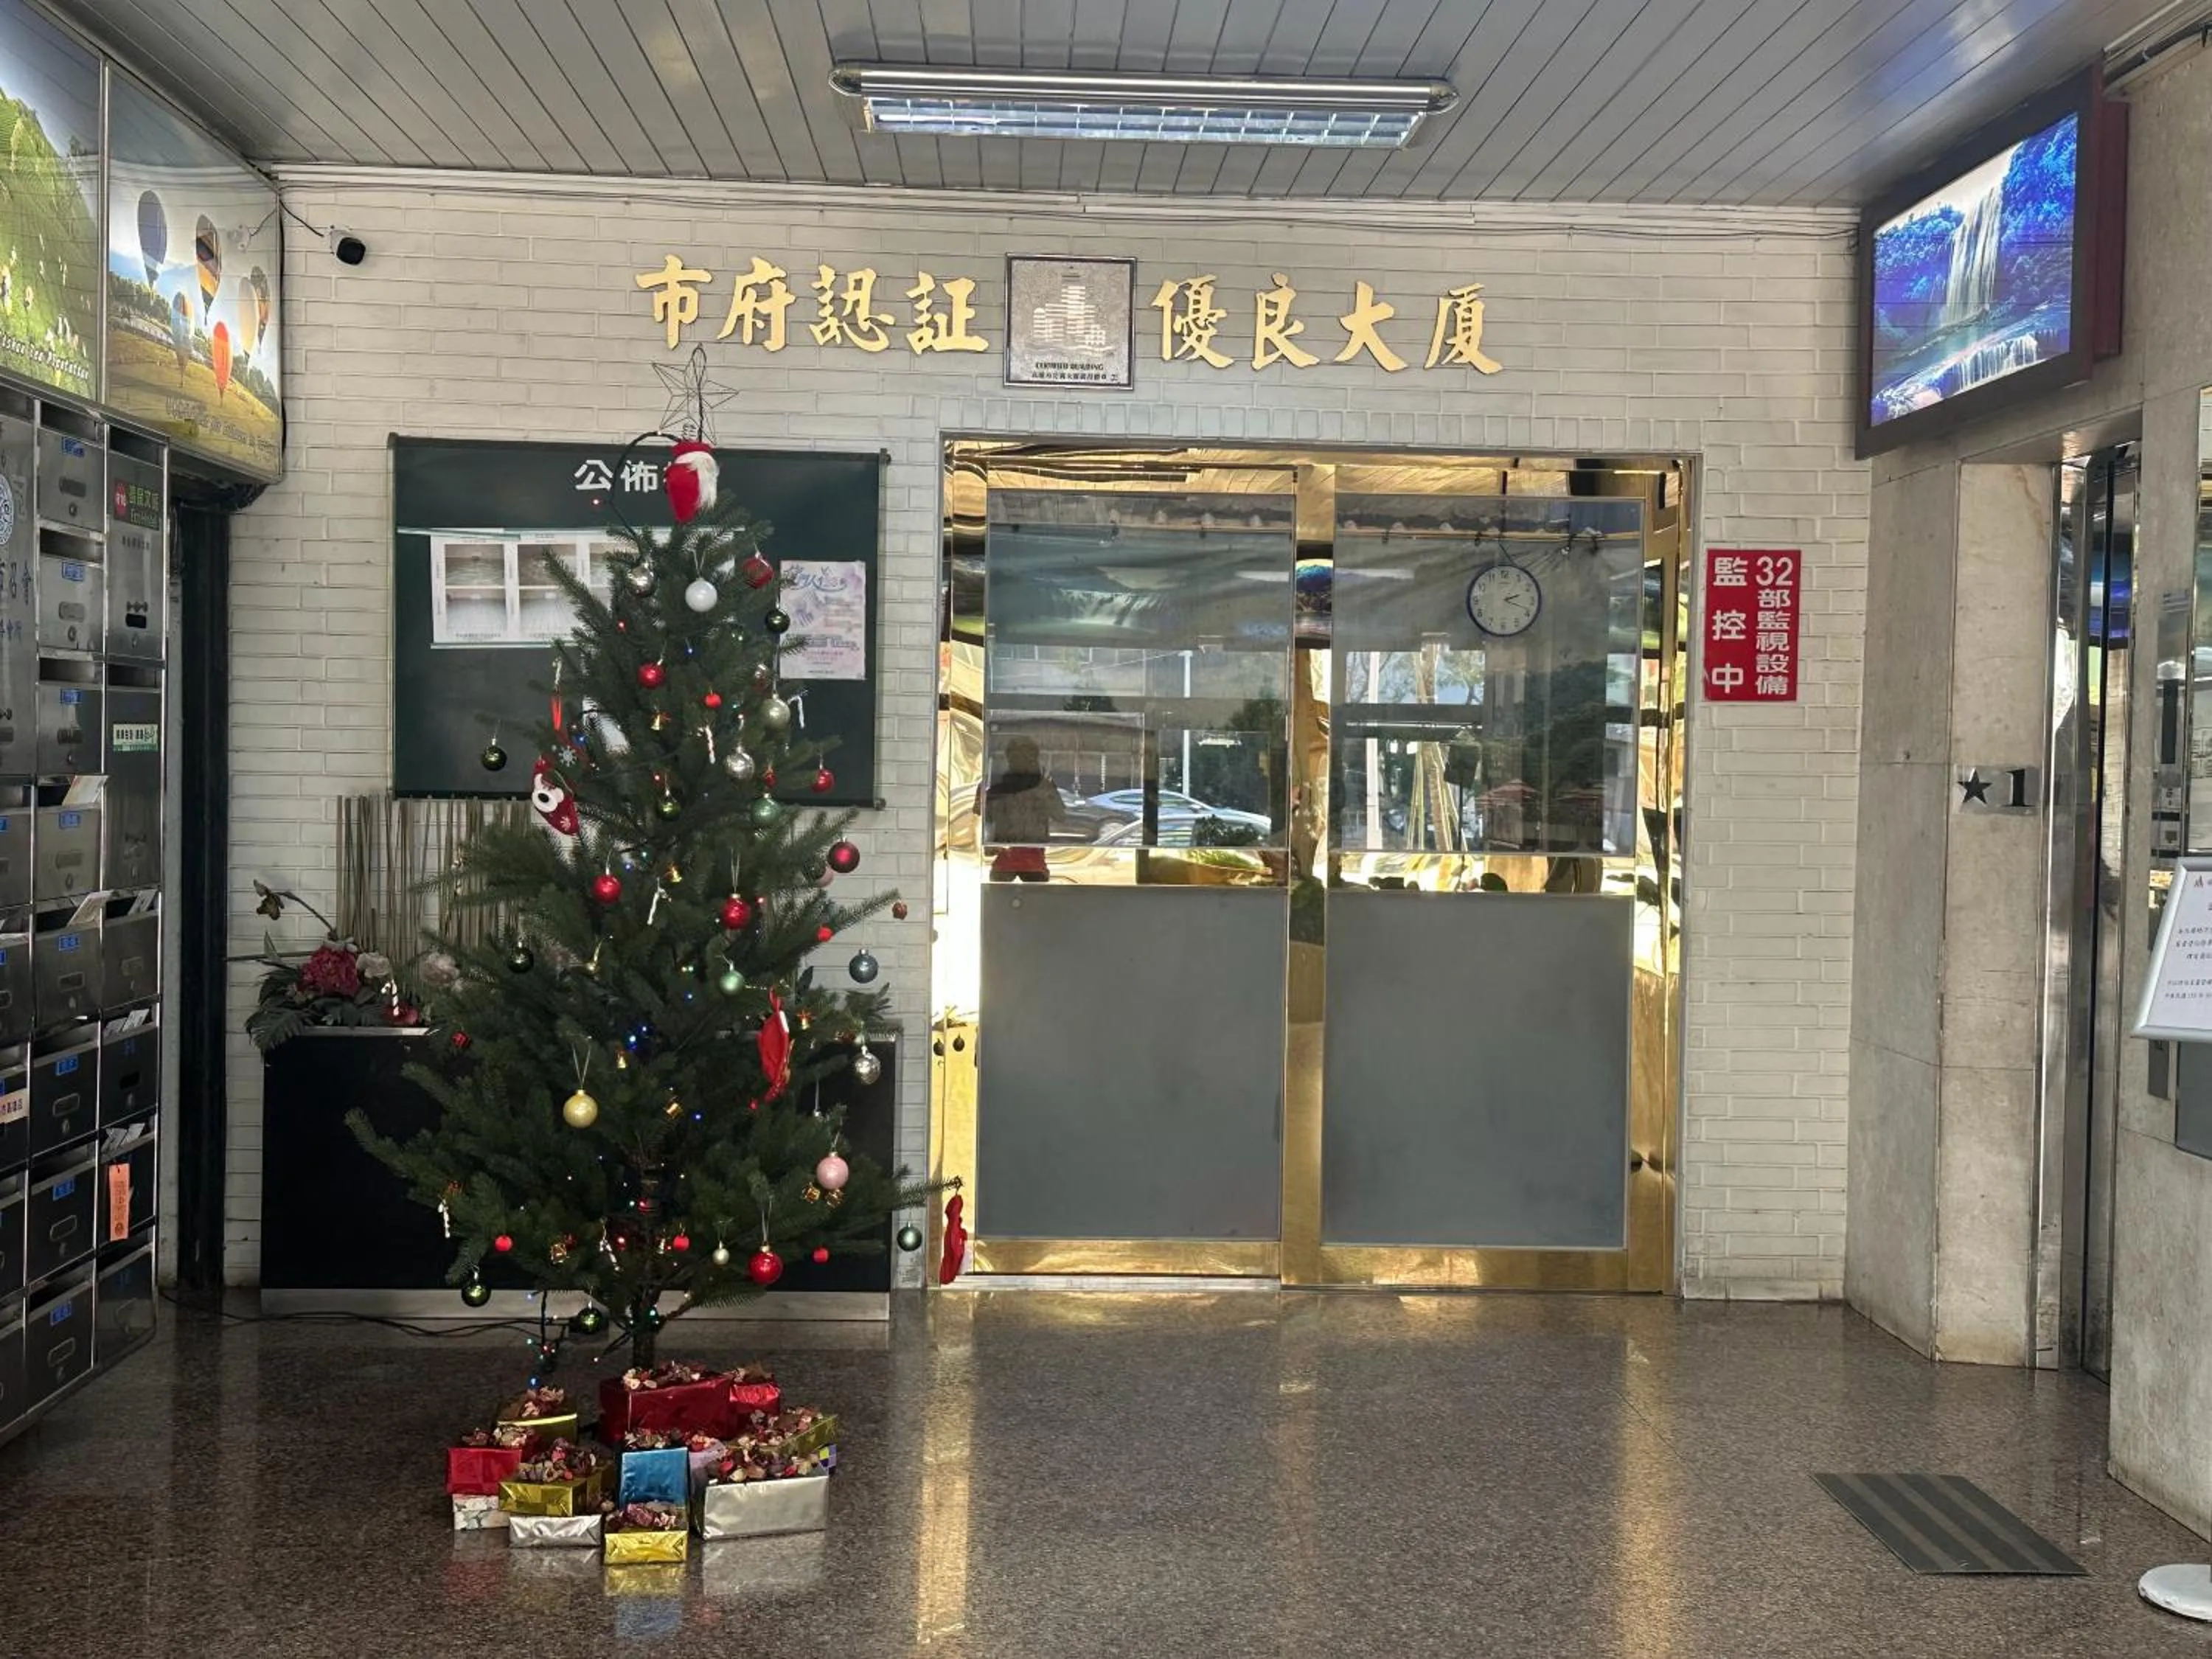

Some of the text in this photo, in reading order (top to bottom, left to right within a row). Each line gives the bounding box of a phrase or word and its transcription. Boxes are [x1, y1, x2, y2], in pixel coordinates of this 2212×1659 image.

[574, 459, 672, 493] 公佈
[1711, 557, 1747, 693] 監控中
[1756, 556, 1793, 695] 32部監視設備
[2003, 768, 2035, 807] 1
